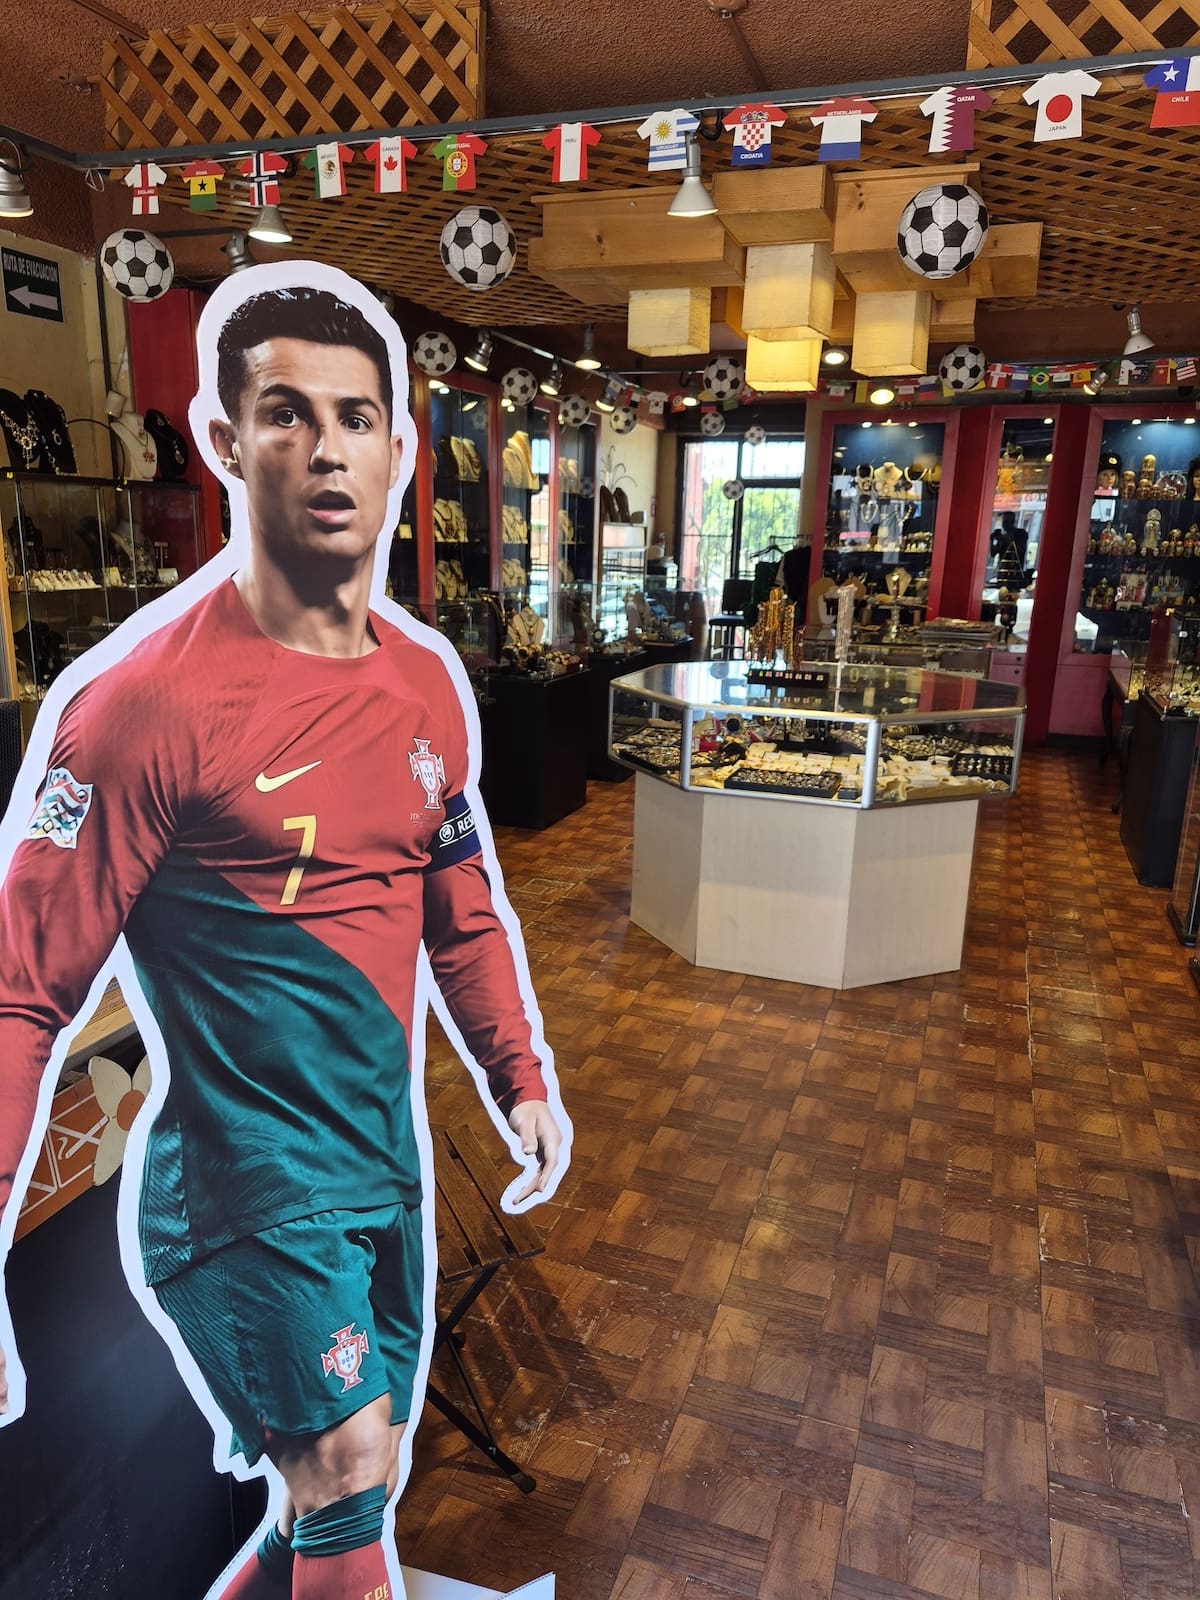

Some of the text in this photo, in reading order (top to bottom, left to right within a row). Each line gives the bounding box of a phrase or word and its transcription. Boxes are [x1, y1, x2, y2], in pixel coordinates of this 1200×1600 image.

[956, 95, 976, 103] QATAR
[1171, 95, 1190, 103] CHILE
[827, 109, 862, 117] NETHERLANDS
[1048, 124, 1067, 132] JAPAN
[446, 142, 471, 150] PORTUGAL
[740, 152, 764, 160] CROATIA
[17, 256, 26, 275] DE
[280, 815, 317, 906] 7
